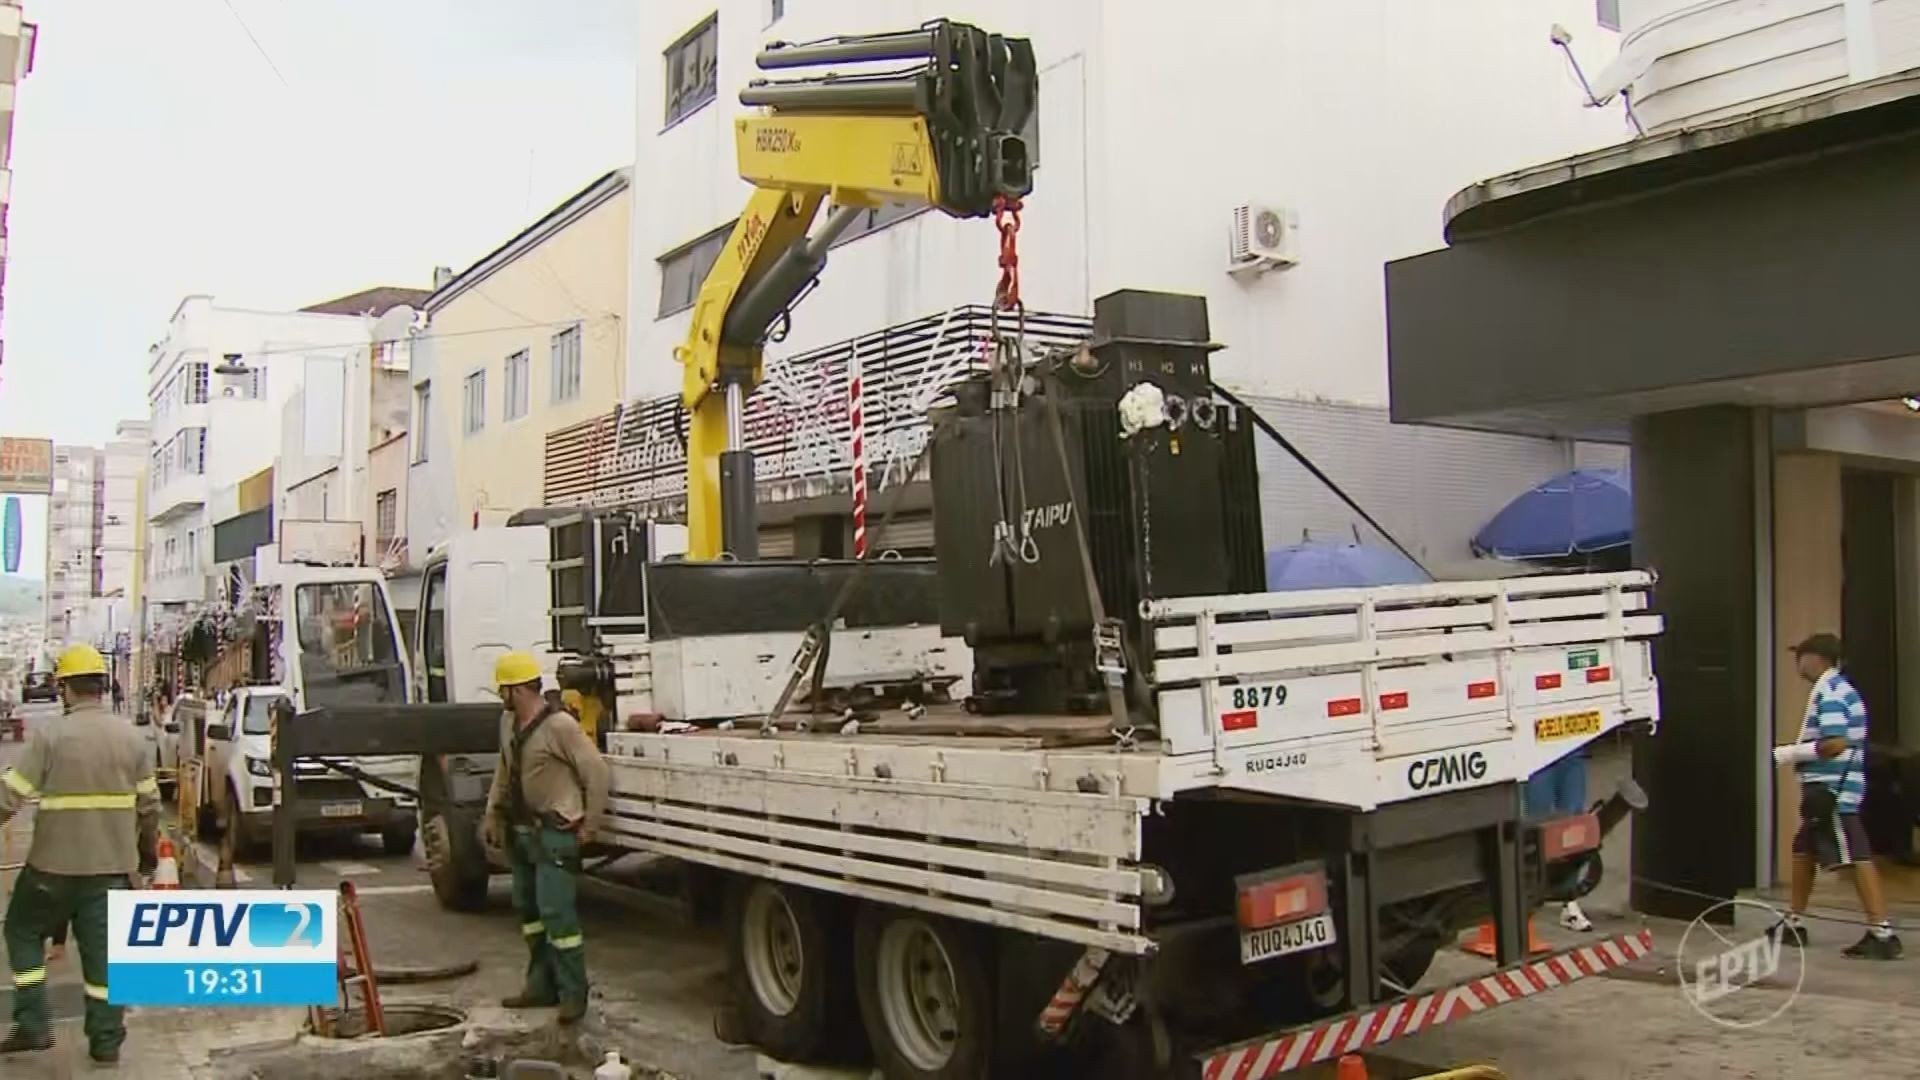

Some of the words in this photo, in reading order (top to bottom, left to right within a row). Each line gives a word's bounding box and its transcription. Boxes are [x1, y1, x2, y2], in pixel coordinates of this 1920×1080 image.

[1233, 685, 1288, 709] 8879
[1246, 753, 1307, 773] RUQ4J40
[1251, 920, 1326, 958] RUQ4J40
